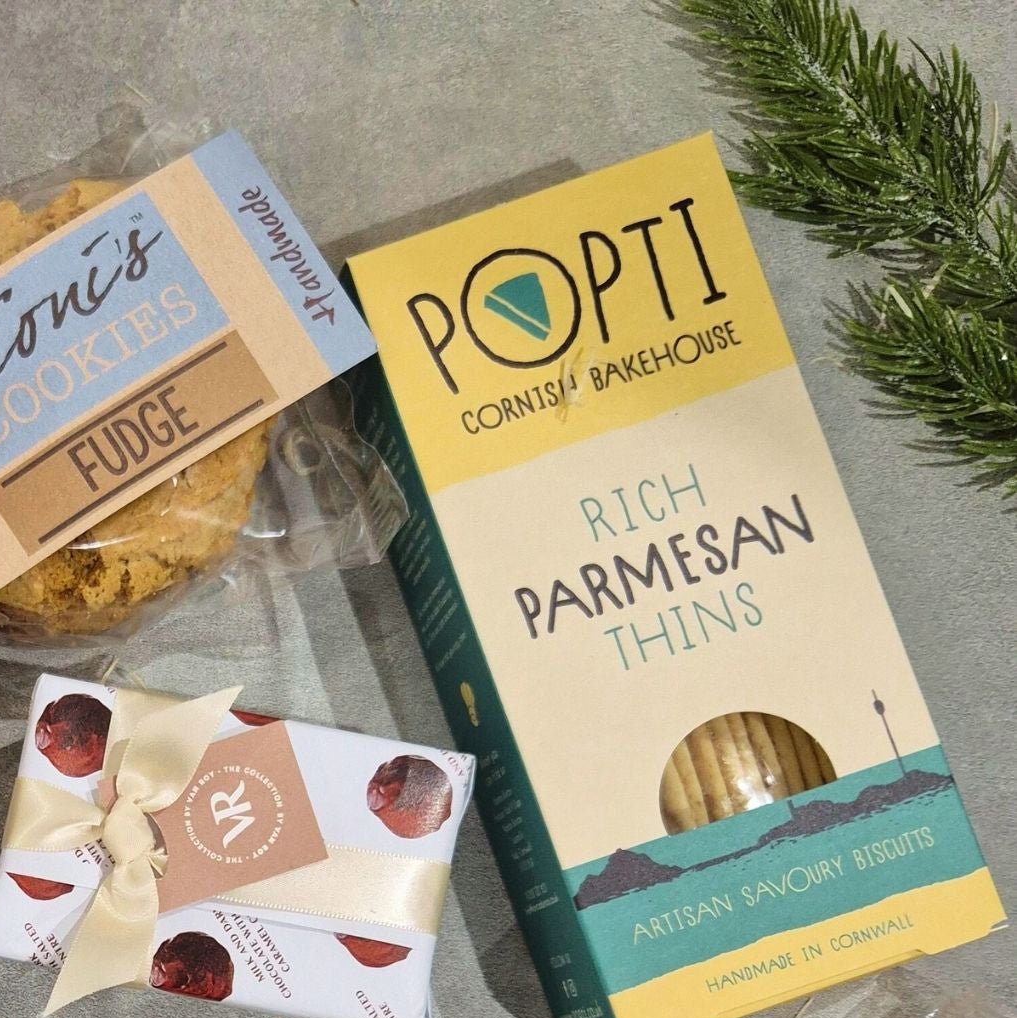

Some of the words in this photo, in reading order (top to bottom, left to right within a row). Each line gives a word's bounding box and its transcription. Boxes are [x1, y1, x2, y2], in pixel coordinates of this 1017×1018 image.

[238, 185, 334, 327] Handmade
[406, 198, 727, 394] POPTI
[461, 374, 577, 434] CORNISH
[589, 321, 742, 393] BAKEHOUSE
[67, 386, 199, 492] FUDGE
[580, 463, 706, 542] RICH
[514, 494, 815, 639] PARMESAN
[605, 582, 764, 671] THINS
[198, 770, 215, 786] ROY
[223, 765, 240, 773] THE
[244, 767, 283, 807] COLLECTION
[184, 806, 191, 817] BY
[187, 785, 200, 803] VAN
[268, 827, 282, 844] VAN
[276, 813, 284, 824] BY
[184, 820, 223, 861] COLLECTION
[252, 844, 269, 859] ROY
[632, 892, 733, 946] ARTISAN
[740, 854, 845, 908] SAVOURY
[854, 826, 935, 870] BISCUITS
[24, 922, 50, 960] SALTED
[213, 910, 232, 932] DAR
[230, 934, 247, 954] AND
[257, 925, 290, 972] CARAMEL
[705, 952, 796, 993] HANDMADE
[803, 944, 823, 963] IN
[830, 913, 915, 952] CORNWALL
[245, 956, 266, 983] MILK
[250, 939, 292, 999] CHOCOLATE
